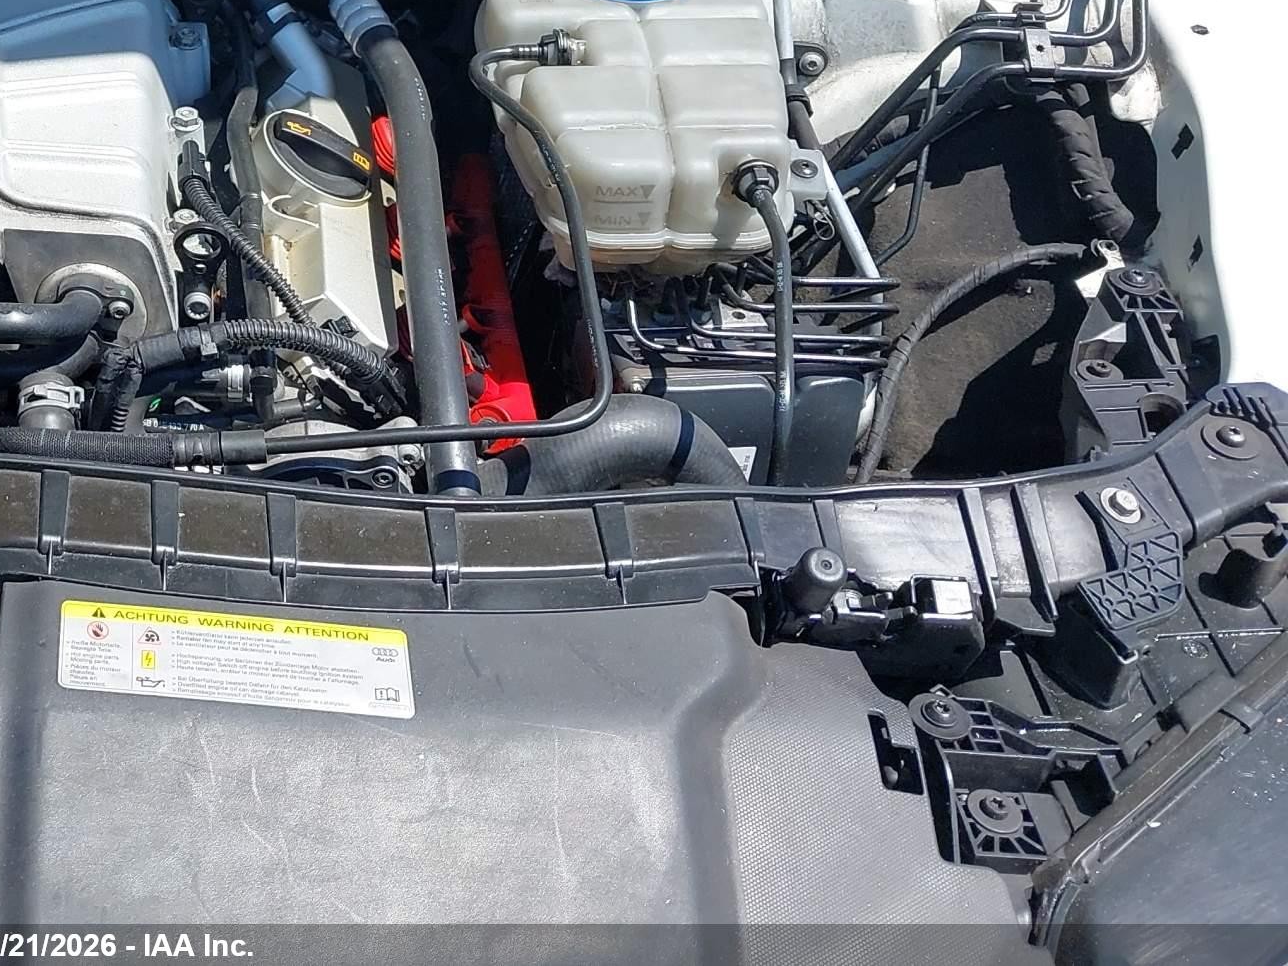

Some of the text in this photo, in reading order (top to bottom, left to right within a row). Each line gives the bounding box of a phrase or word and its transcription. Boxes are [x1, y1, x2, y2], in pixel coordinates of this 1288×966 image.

[596, 185, 638, 196] MAX
[594, 215, 632, 226] MIN
[114, 610, 369, 641] ACHTUNG WARNING ATTENTION
